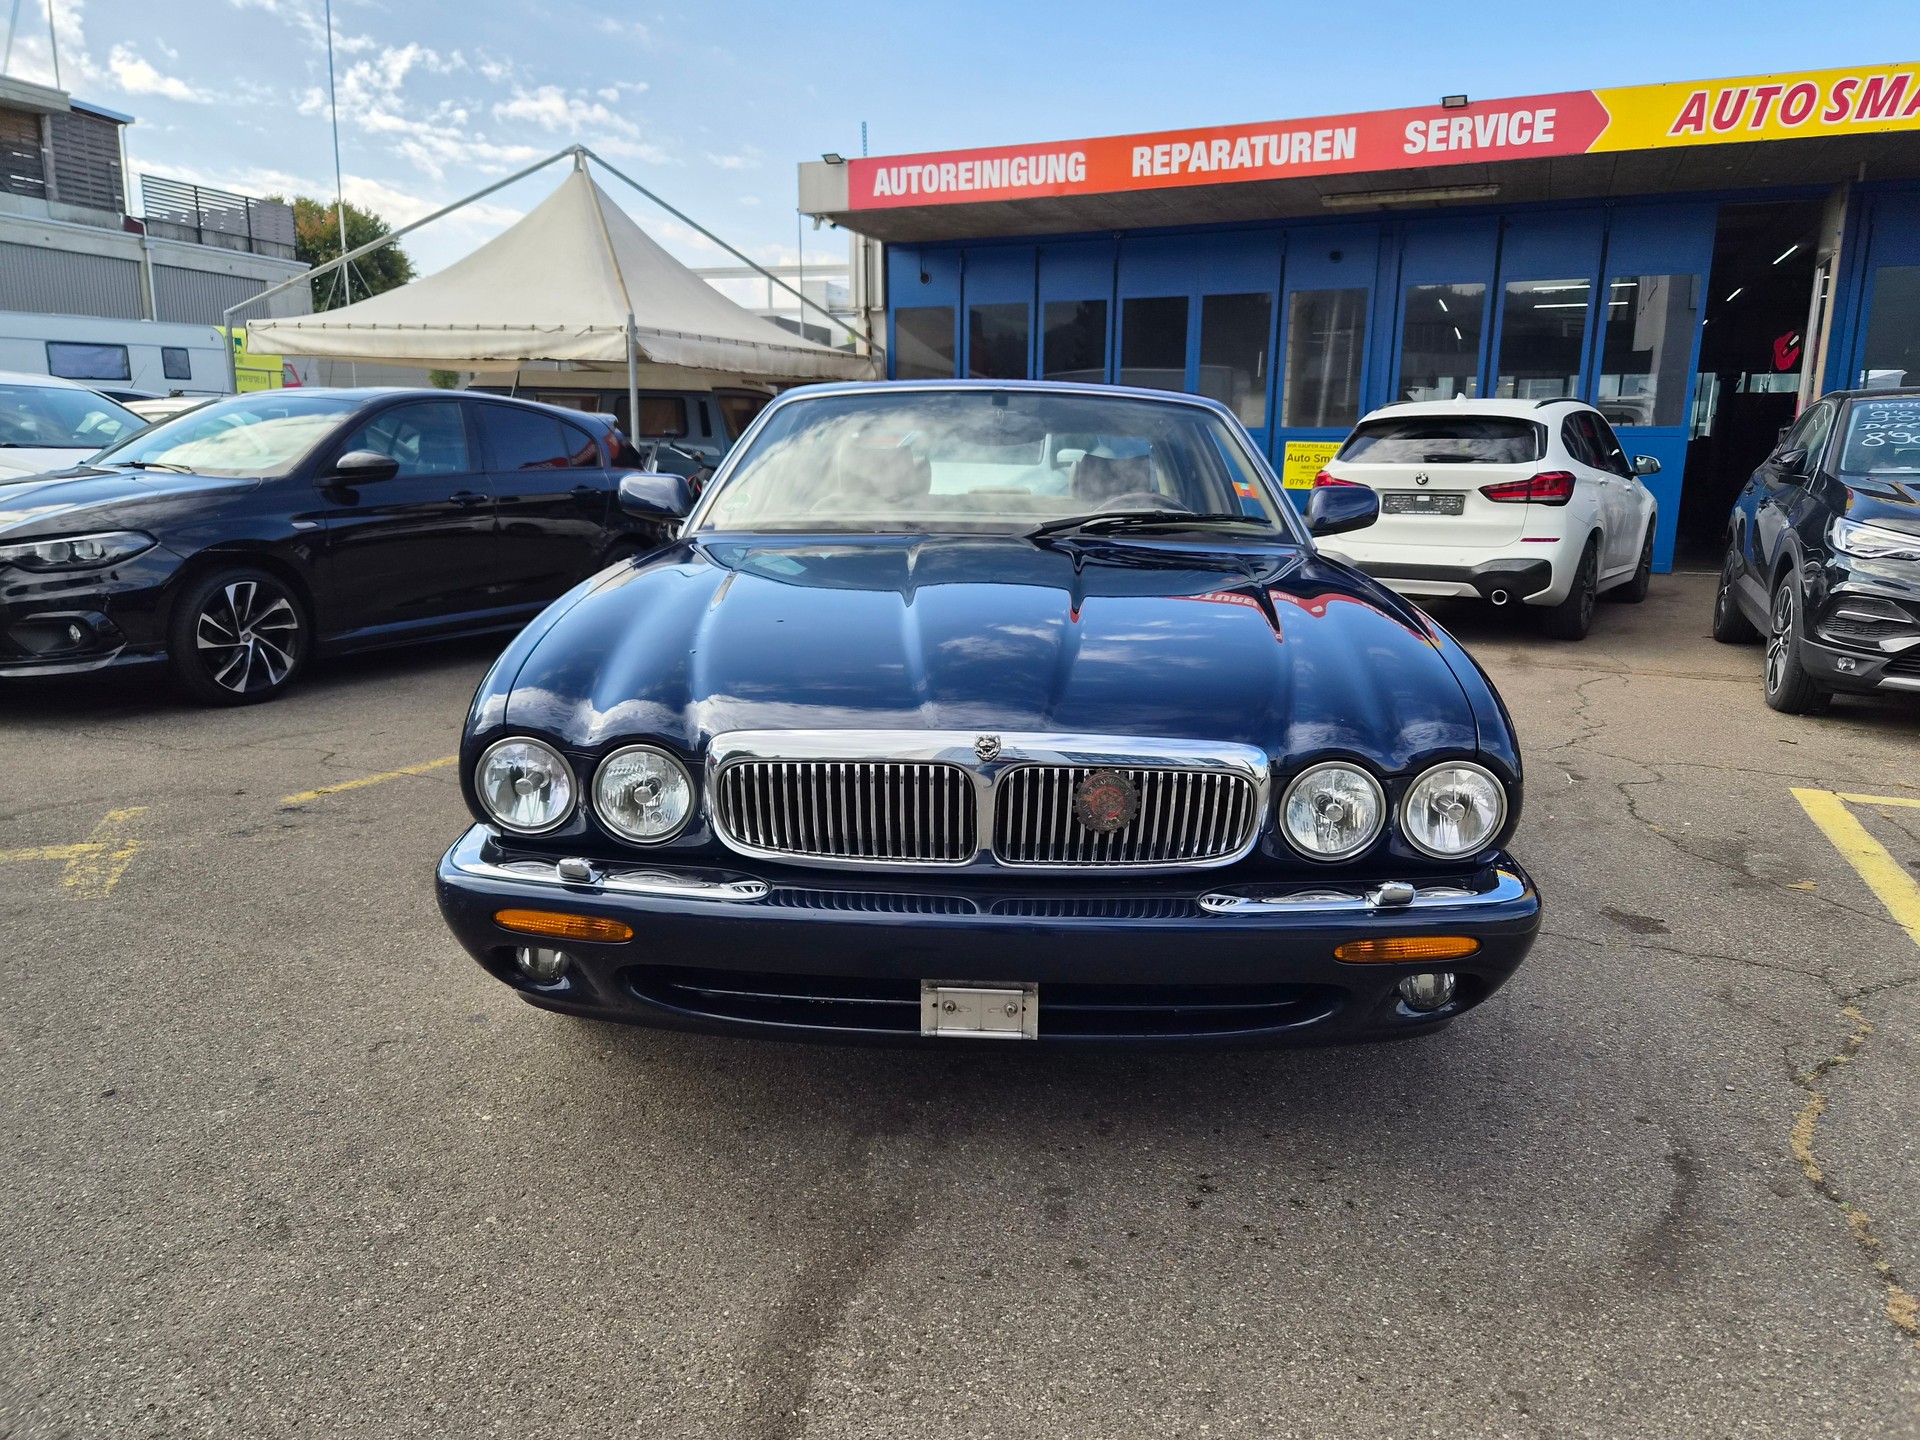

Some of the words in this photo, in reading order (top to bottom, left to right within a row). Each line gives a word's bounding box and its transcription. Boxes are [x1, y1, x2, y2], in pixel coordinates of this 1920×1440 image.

[1668, 81, 1818, 135] AUTO
[873, 151, 1086, 197] AUTOREINIGUNG
[1132, 126, 1357, 178] REPARATUREN
[1403, 108, 1556, 154] SERVICE
[1286, 453, 1311, 463] Auto
